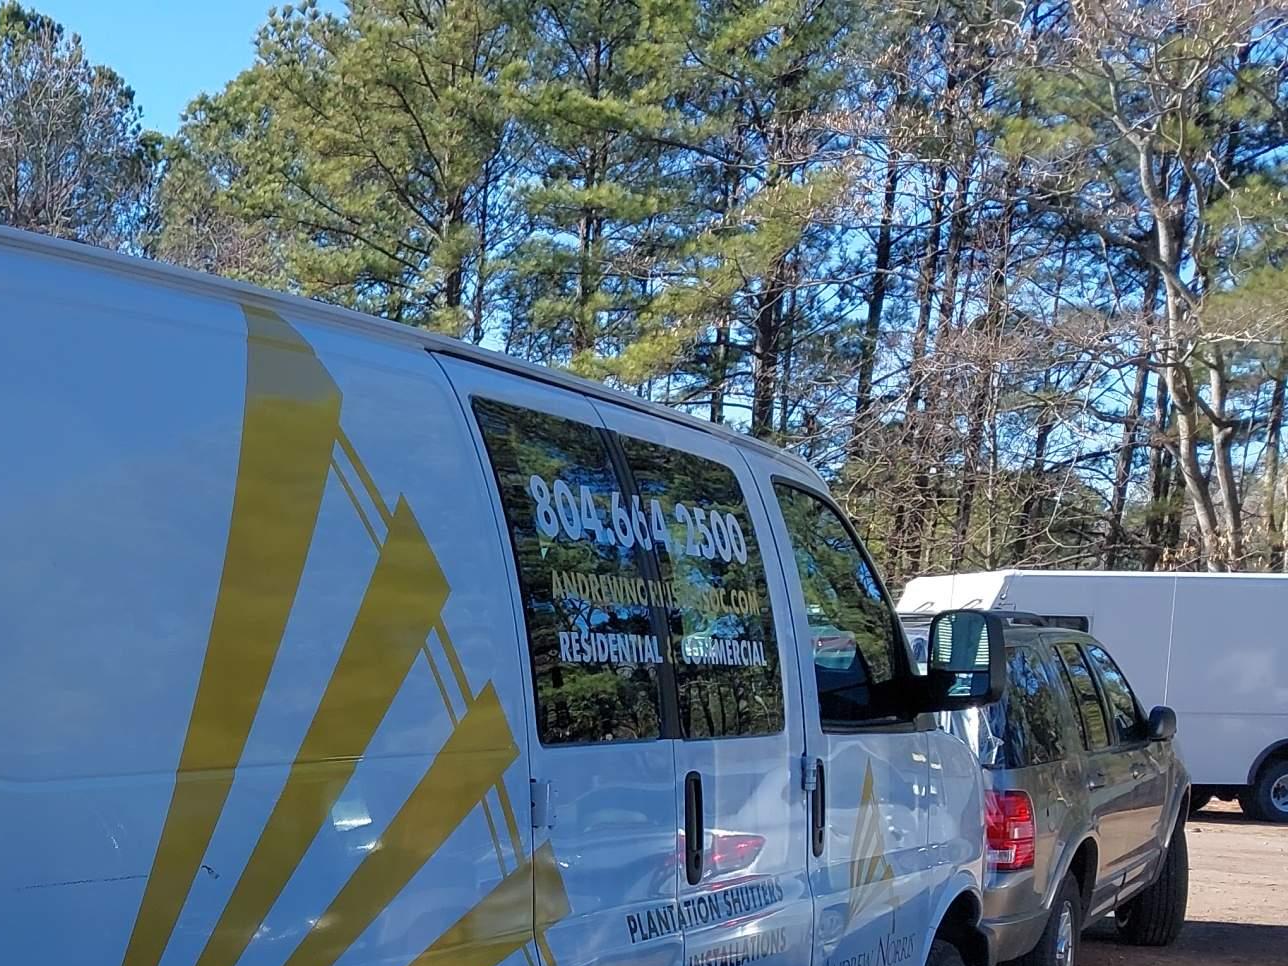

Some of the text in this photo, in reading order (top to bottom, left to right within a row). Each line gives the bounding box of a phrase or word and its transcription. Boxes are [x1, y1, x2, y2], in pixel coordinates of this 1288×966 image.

[559, 631, 663, 664] RESIDENTIAL
[626, 876, 784, 944] PLANTATION SHUTTERS
